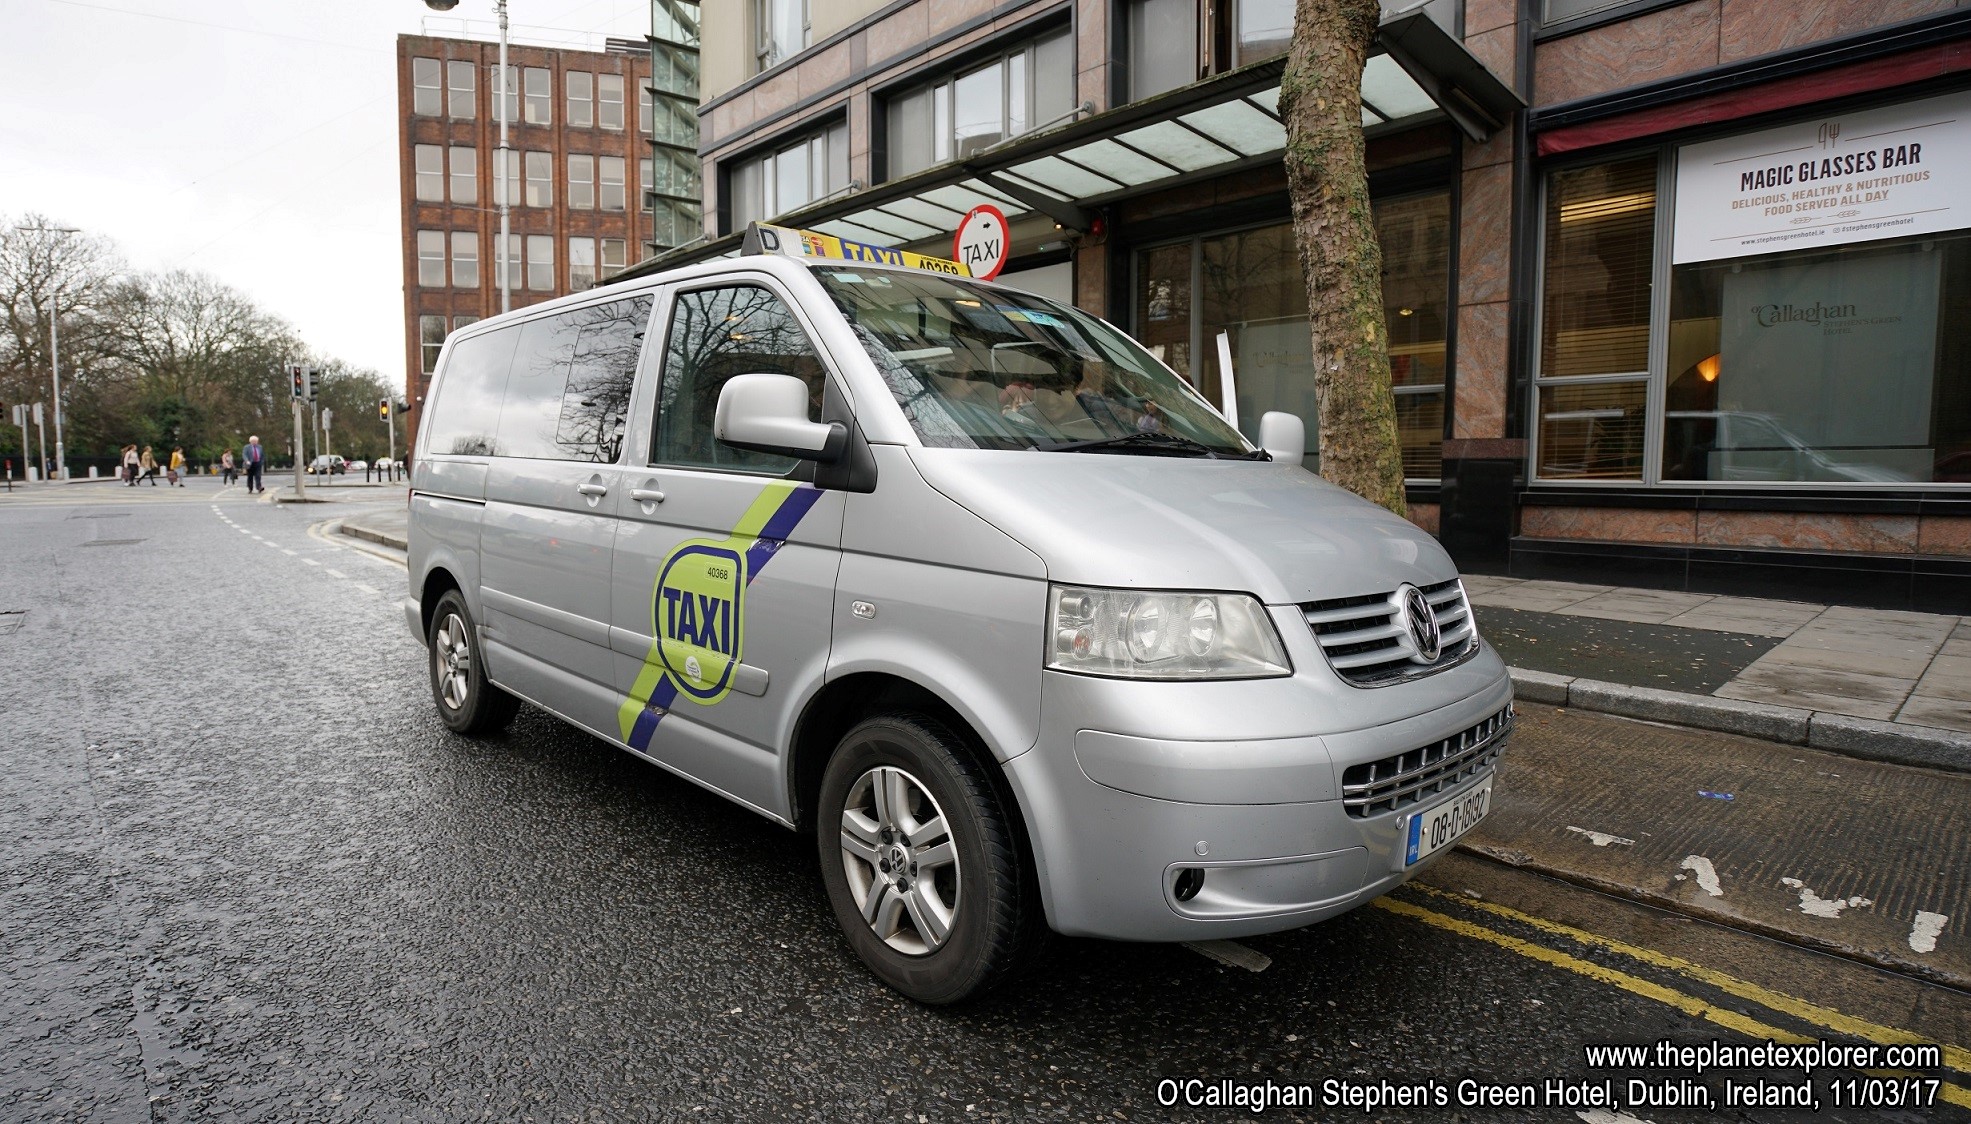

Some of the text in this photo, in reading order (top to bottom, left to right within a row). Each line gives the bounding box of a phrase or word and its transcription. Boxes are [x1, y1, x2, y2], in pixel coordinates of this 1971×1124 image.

[1741, 143, 1921, 192] MAGIC GLASSES BAR
[1732, 170, 1930, 210] DELICIOUS, HEALTHY & NUTRITIOUS
[1764, 190, 1889, 217] FOOD SERVED ALL DAY
[759, 228, 779, 251] D
[1741, 230, 1825, 246] www.stephensgreenhotel.ie
[845, 242, 900, 266] TAXI
[963, 239, 999, 264] TAXI
[707, 567, 728, 580] 40368
[663, 587, 730, 655] TAXI
[1431, 789, 1485, 849] 08-D-18192
